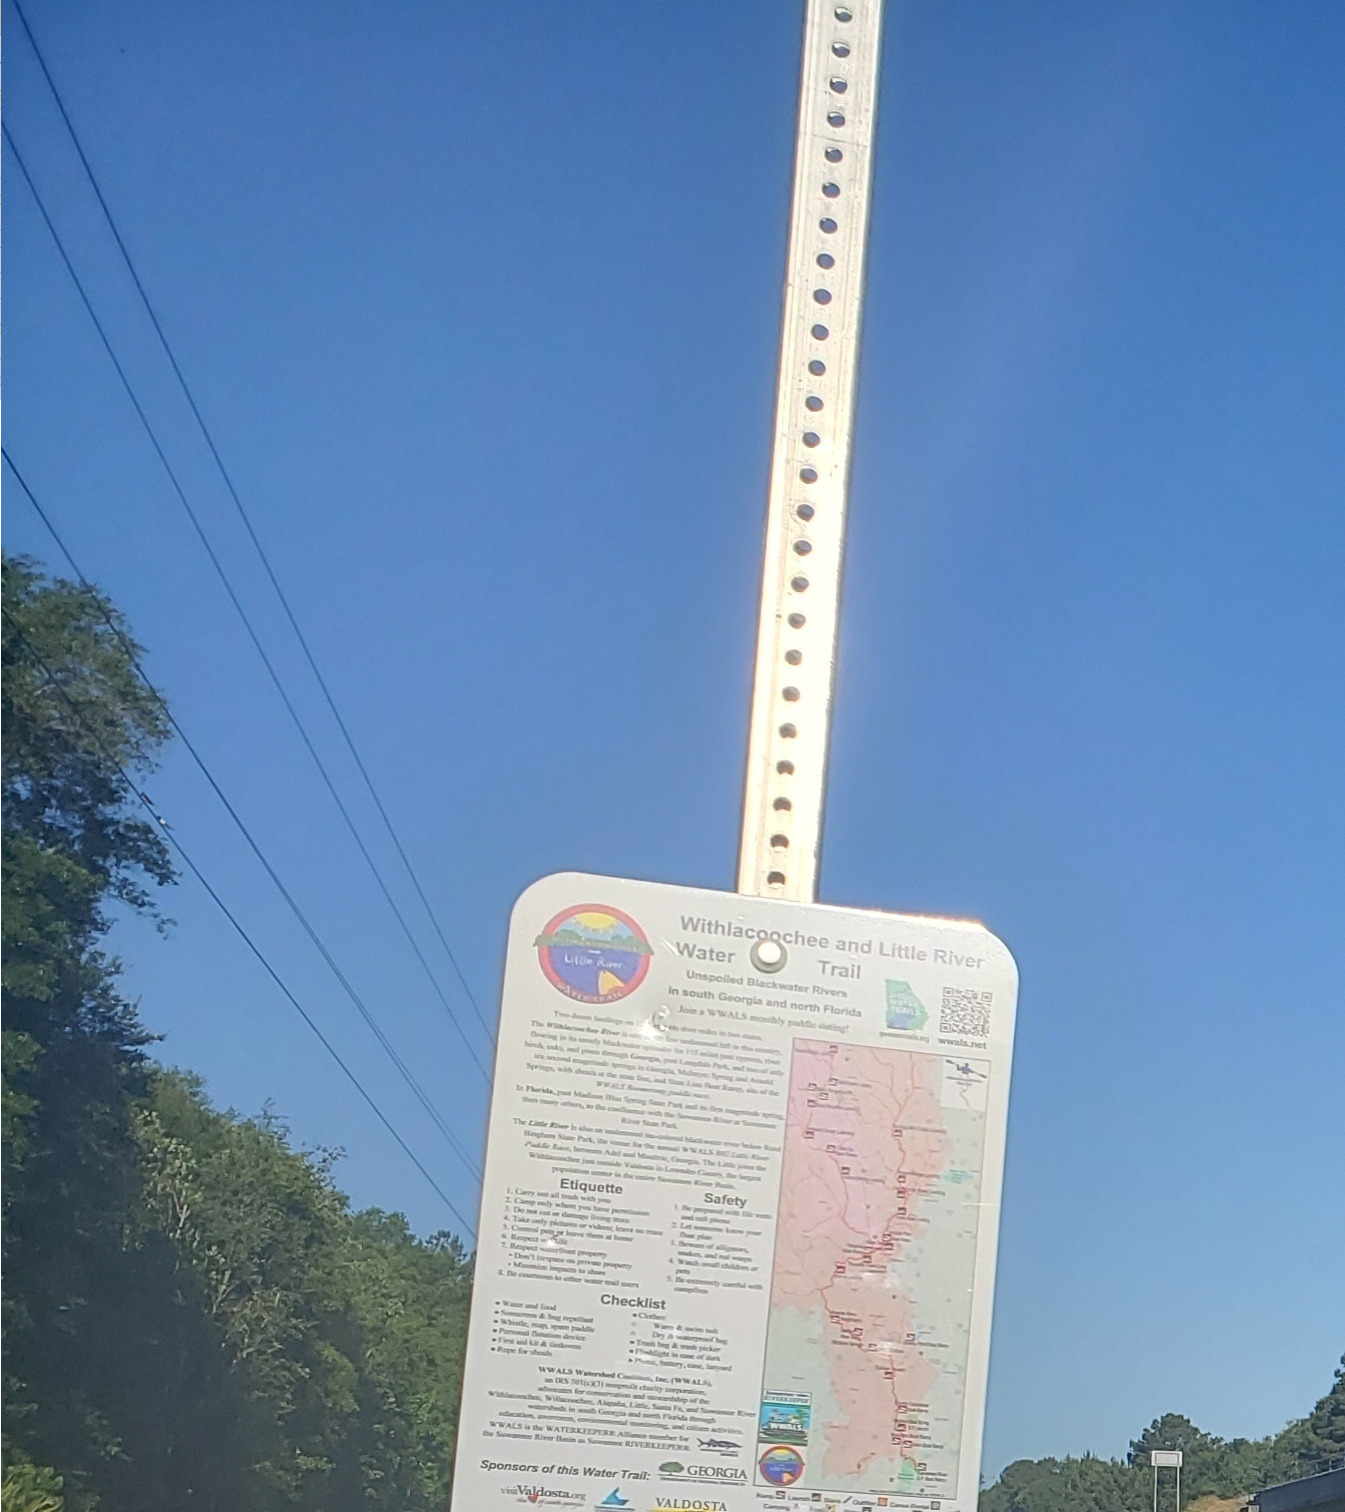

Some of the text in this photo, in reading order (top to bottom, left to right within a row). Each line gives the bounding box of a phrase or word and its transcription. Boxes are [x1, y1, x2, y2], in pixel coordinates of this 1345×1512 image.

[679, 914, 986, 970] Withlacoochee and Little River
[564, 953, 623, 969] Little River
[675, 941, 861, 979] Water Trail
[685, 969, 848, 998] Unspoiled Blackwater Rivers
[681, 987, 715, 1000] south
[717, 991, 763, 1007] Georgia
[765, 997, 787, 1008] and
[790, 1000, 821, 1012] north
[823, 1004, 862, 1018] Florida
[677, 1004, 697, 1015] Join
[705, 1007, 747, 1021] WWALS
[749, 1012, 785, 1026] monthly
[559, 1178, 623, 1196] Etiquette
[702, 1192, 747, 1209] Safety
[599, 1293, 666, 1310] Checklist
[479, 1459, 651, 1480] Sponsors of this Water Trail:
[686, 1465, 748, 1479] GEORGIA
[654, 1497, 727, 1511] VALDOSTA
